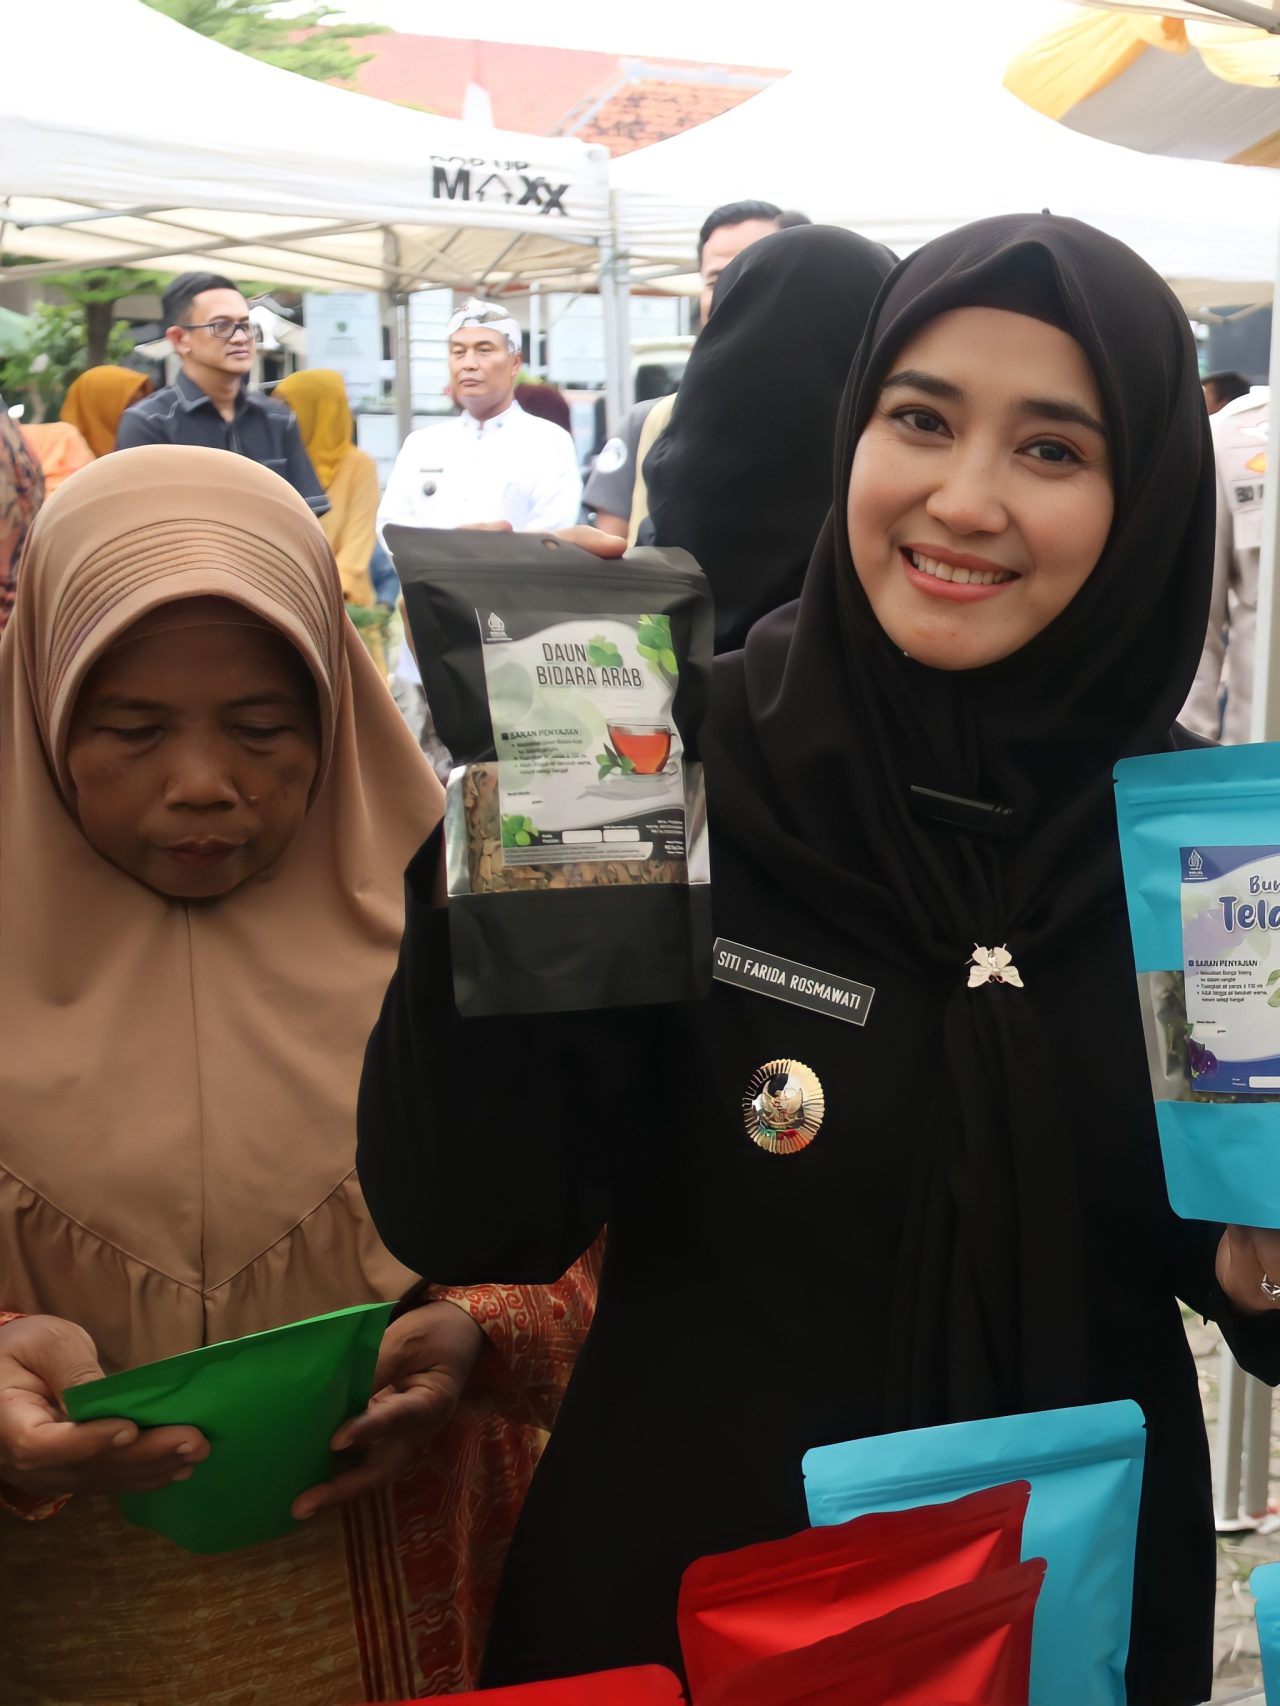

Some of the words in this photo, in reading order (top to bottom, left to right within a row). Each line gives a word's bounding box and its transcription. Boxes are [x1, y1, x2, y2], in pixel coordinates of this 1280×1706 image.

[542, 642, 588, 662] DAUN
[536, 665, 597, 686] BIDARA
[601, 667, 643, 687] ARAB
[717, 950, 741, 972] SITI
[743, 959, 786, 986] FARIDA
[789, 974, 861, 1010] ROSMAWATI
